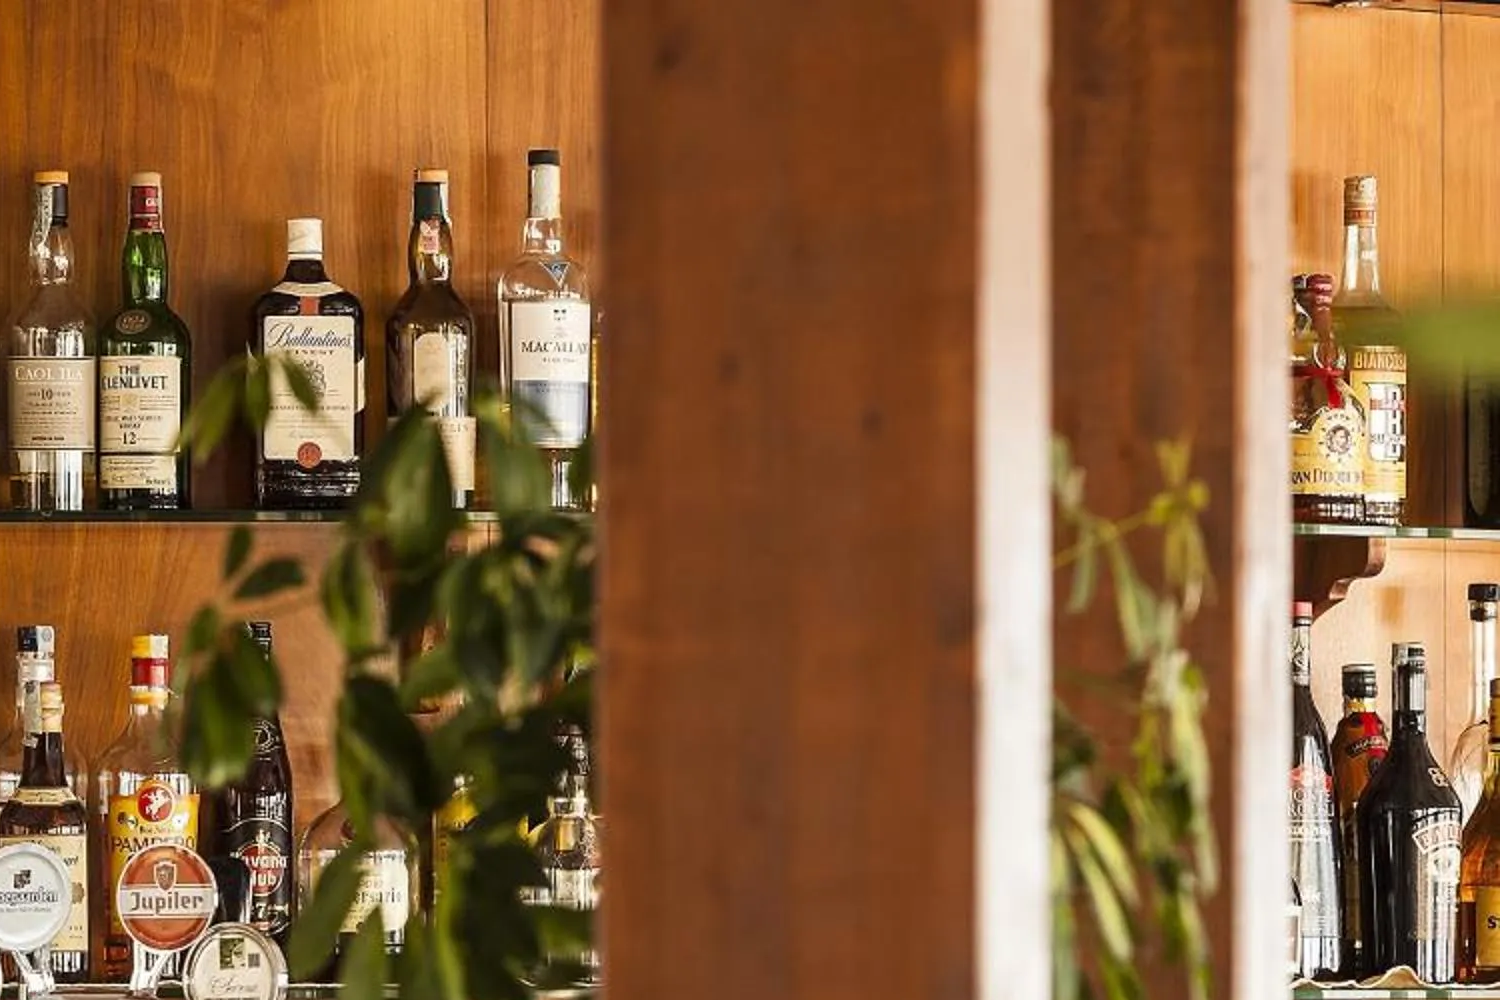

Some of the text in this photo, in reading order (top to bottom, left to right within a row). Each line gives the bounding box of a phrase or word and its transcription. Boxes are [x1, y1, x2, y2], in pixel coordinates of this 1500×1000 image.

[15, 366, 52, 380] CAOL
[118, 364, 141, 375] THE
[41, 388, 53, 400] 10
[122, 431, 137, 445] 12
[251, 870, 277, 888] lub
[130, 891, 204, 916] Jupiler
